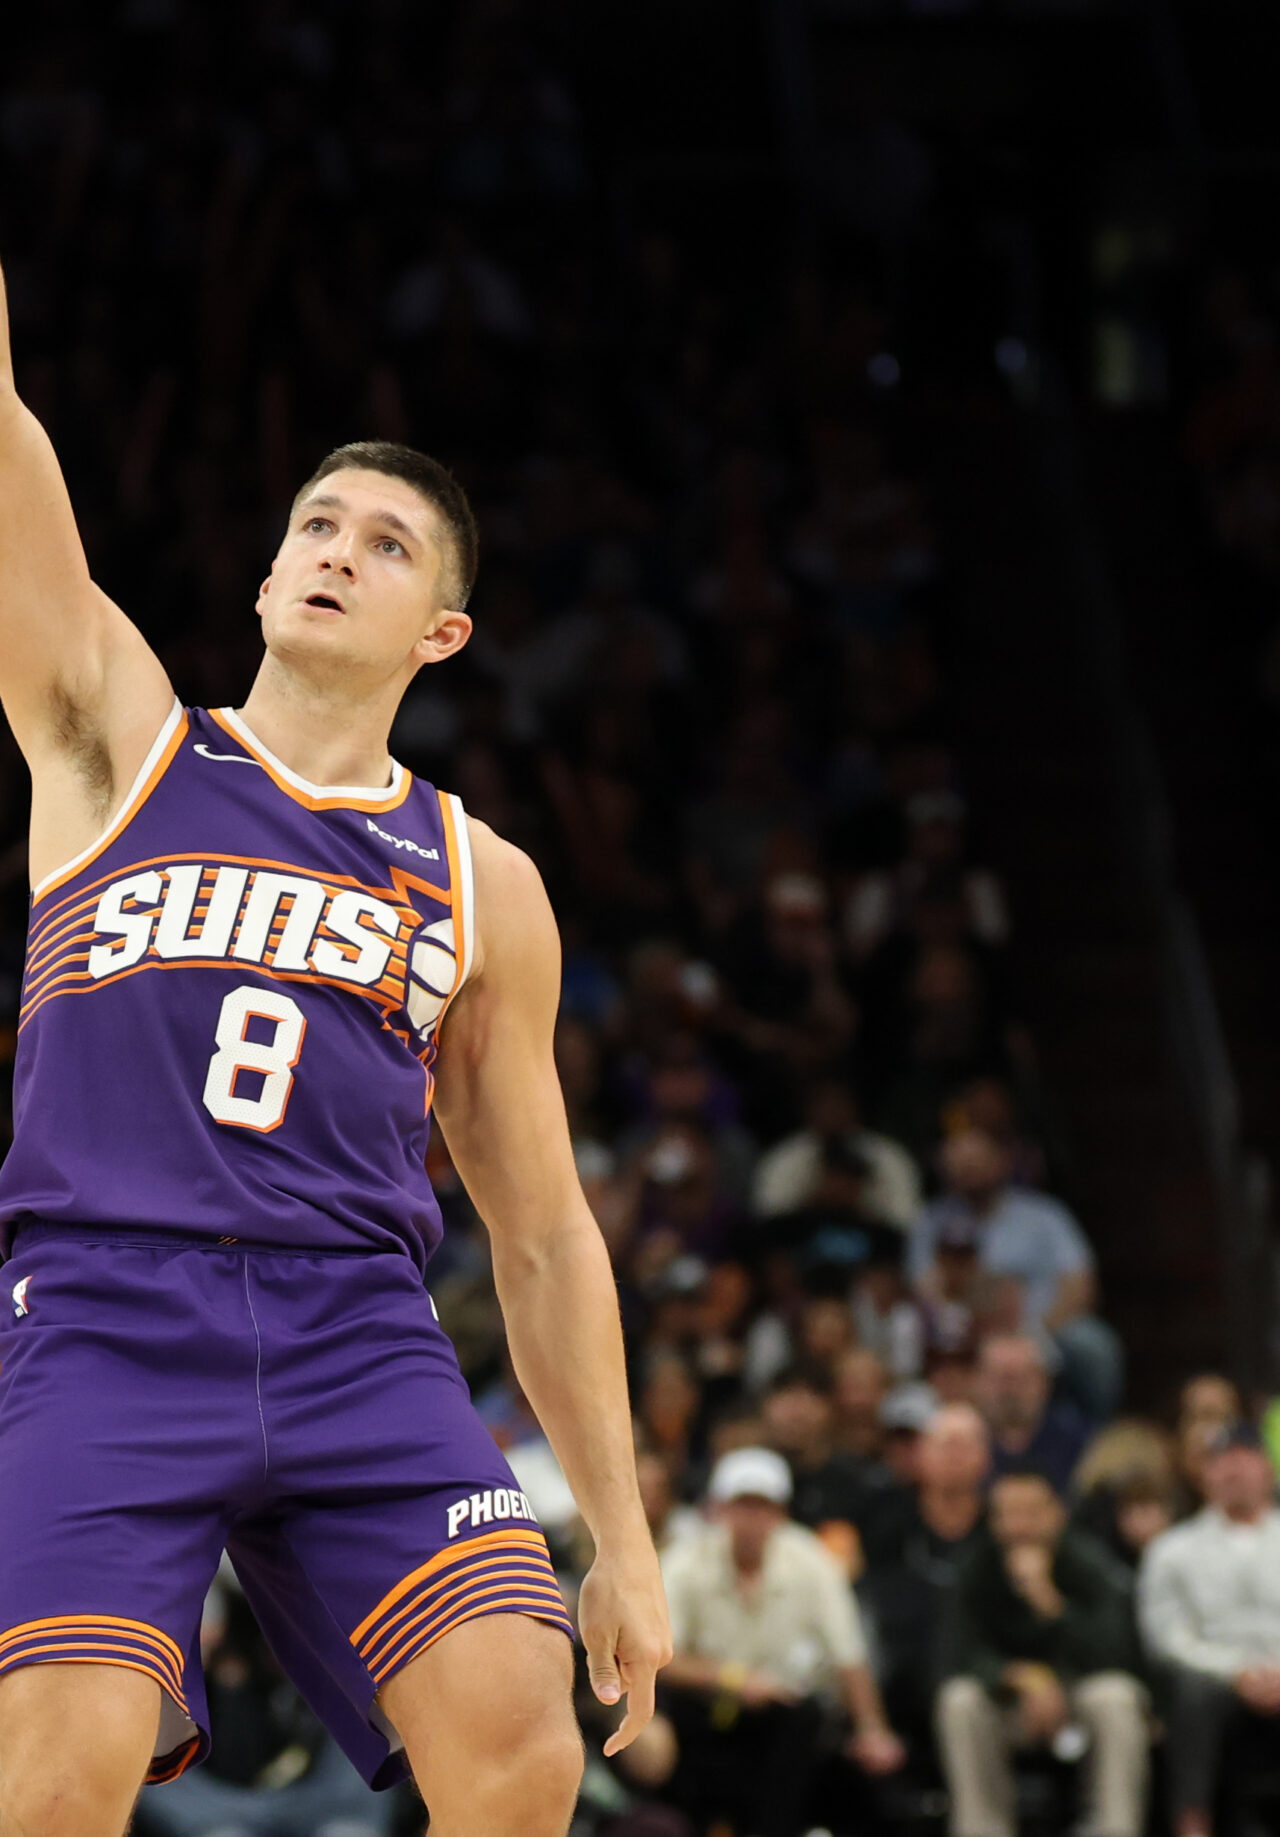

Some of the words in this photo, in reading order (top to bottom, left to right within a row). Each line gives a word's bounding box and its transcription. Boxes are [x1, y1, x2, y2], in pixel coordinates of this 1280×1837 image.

[366, 818, 440, 861] PayPal
[88, 865, 401, 985] SUNS
[203, 985, 307, 1133] 8
